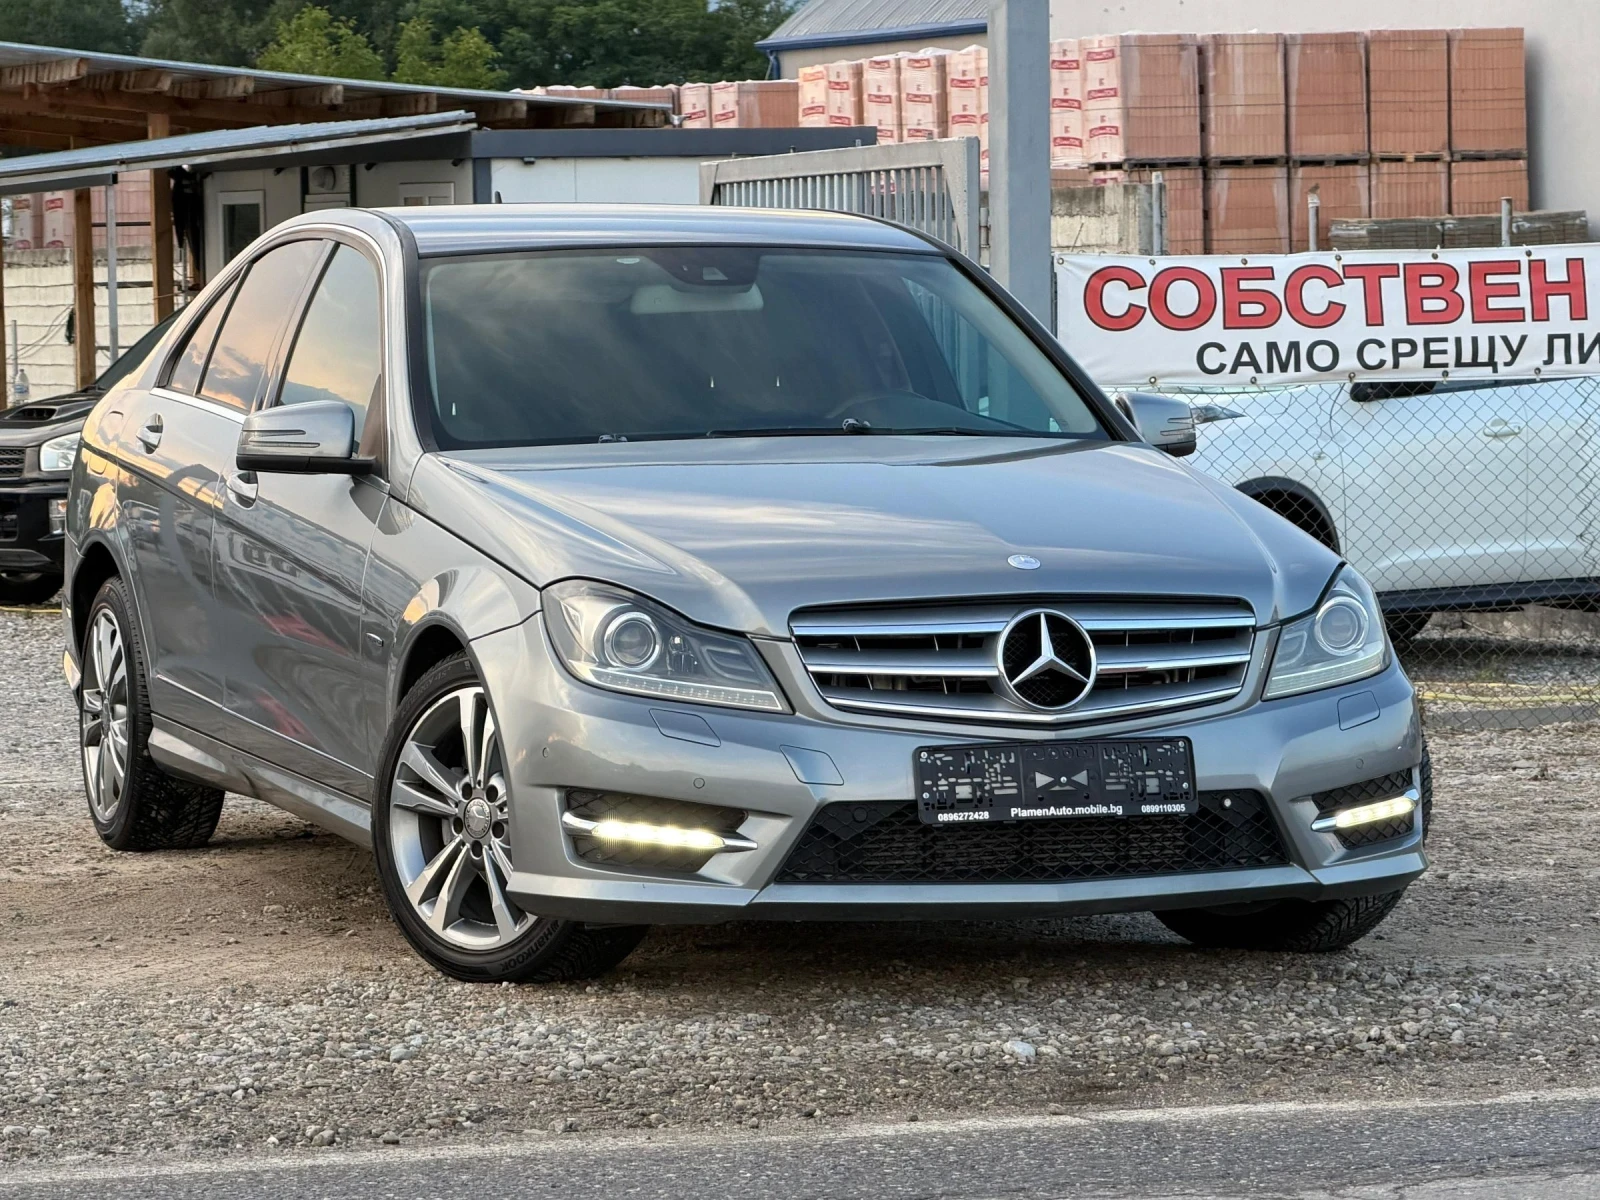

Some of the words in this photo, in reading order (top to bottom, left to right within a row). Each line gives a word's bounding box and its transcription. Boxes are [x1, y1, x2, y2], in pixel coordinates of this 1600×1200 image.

[1084, 257, 1588, 331] СОБСТВЕН
[1196, 339, 1340, 375] САМО
[1357, 334, 1527, 371] СРЕЩУ
[938, 811, 990, 822] 0896272428
[1010, 804, 1123, 818] PlamenAuto.mobile.bg
[1141, 803, 1186, 813] 0899110305
